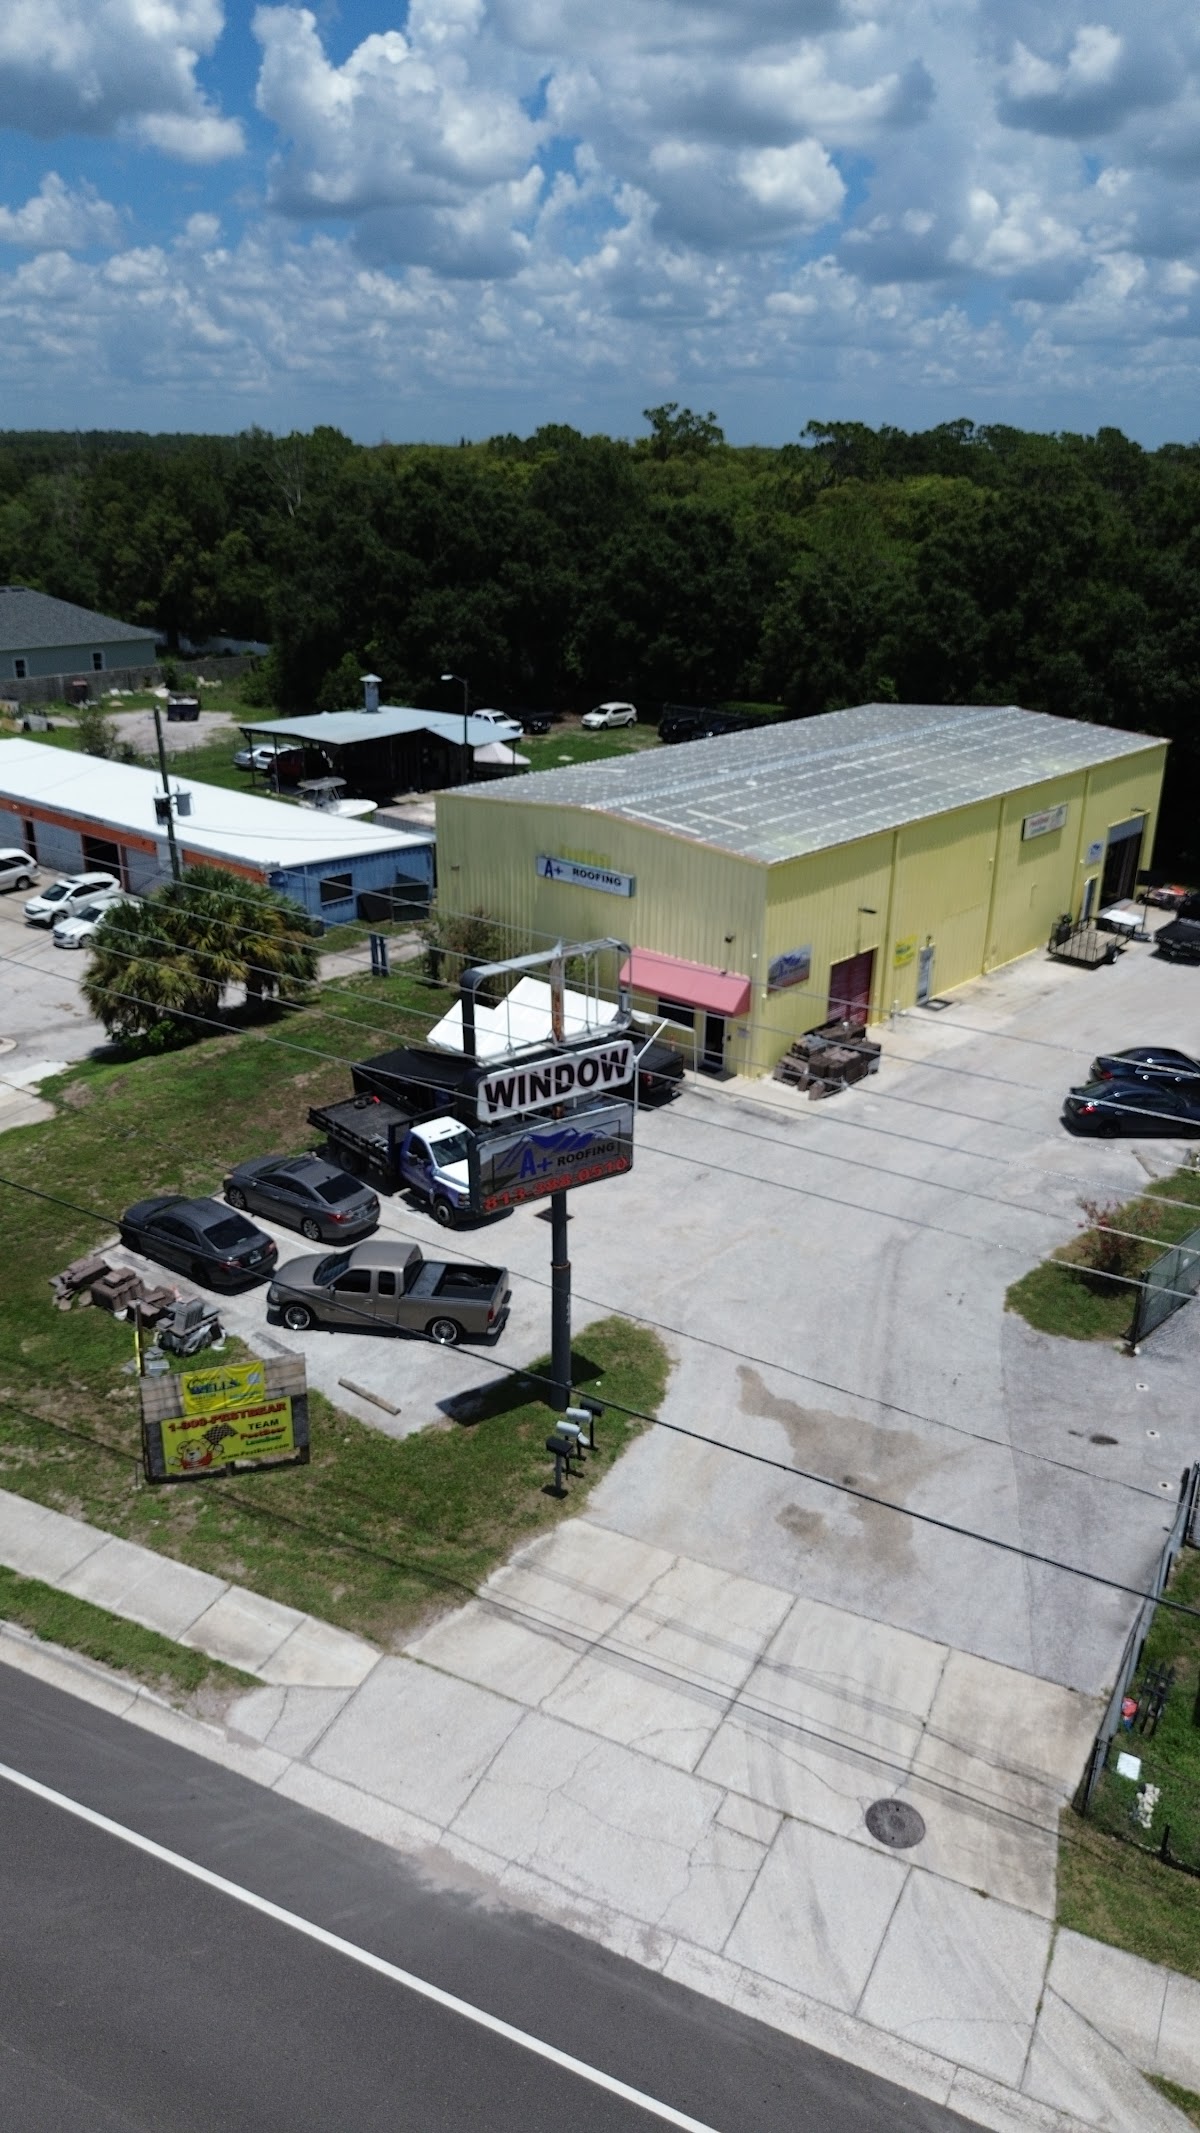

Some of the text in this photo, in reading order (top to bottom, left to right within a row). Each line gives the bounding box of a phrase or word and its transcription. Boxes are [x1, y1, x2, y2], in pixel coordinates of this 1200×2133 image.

[544, 860, 622, 887] A+ ROOFING
[484, 1049, 628, 1114] WINDOW
[519, 1142, 615, 1178] A+ ROOFING
[248, 1419, 280, 1430] TEAM
